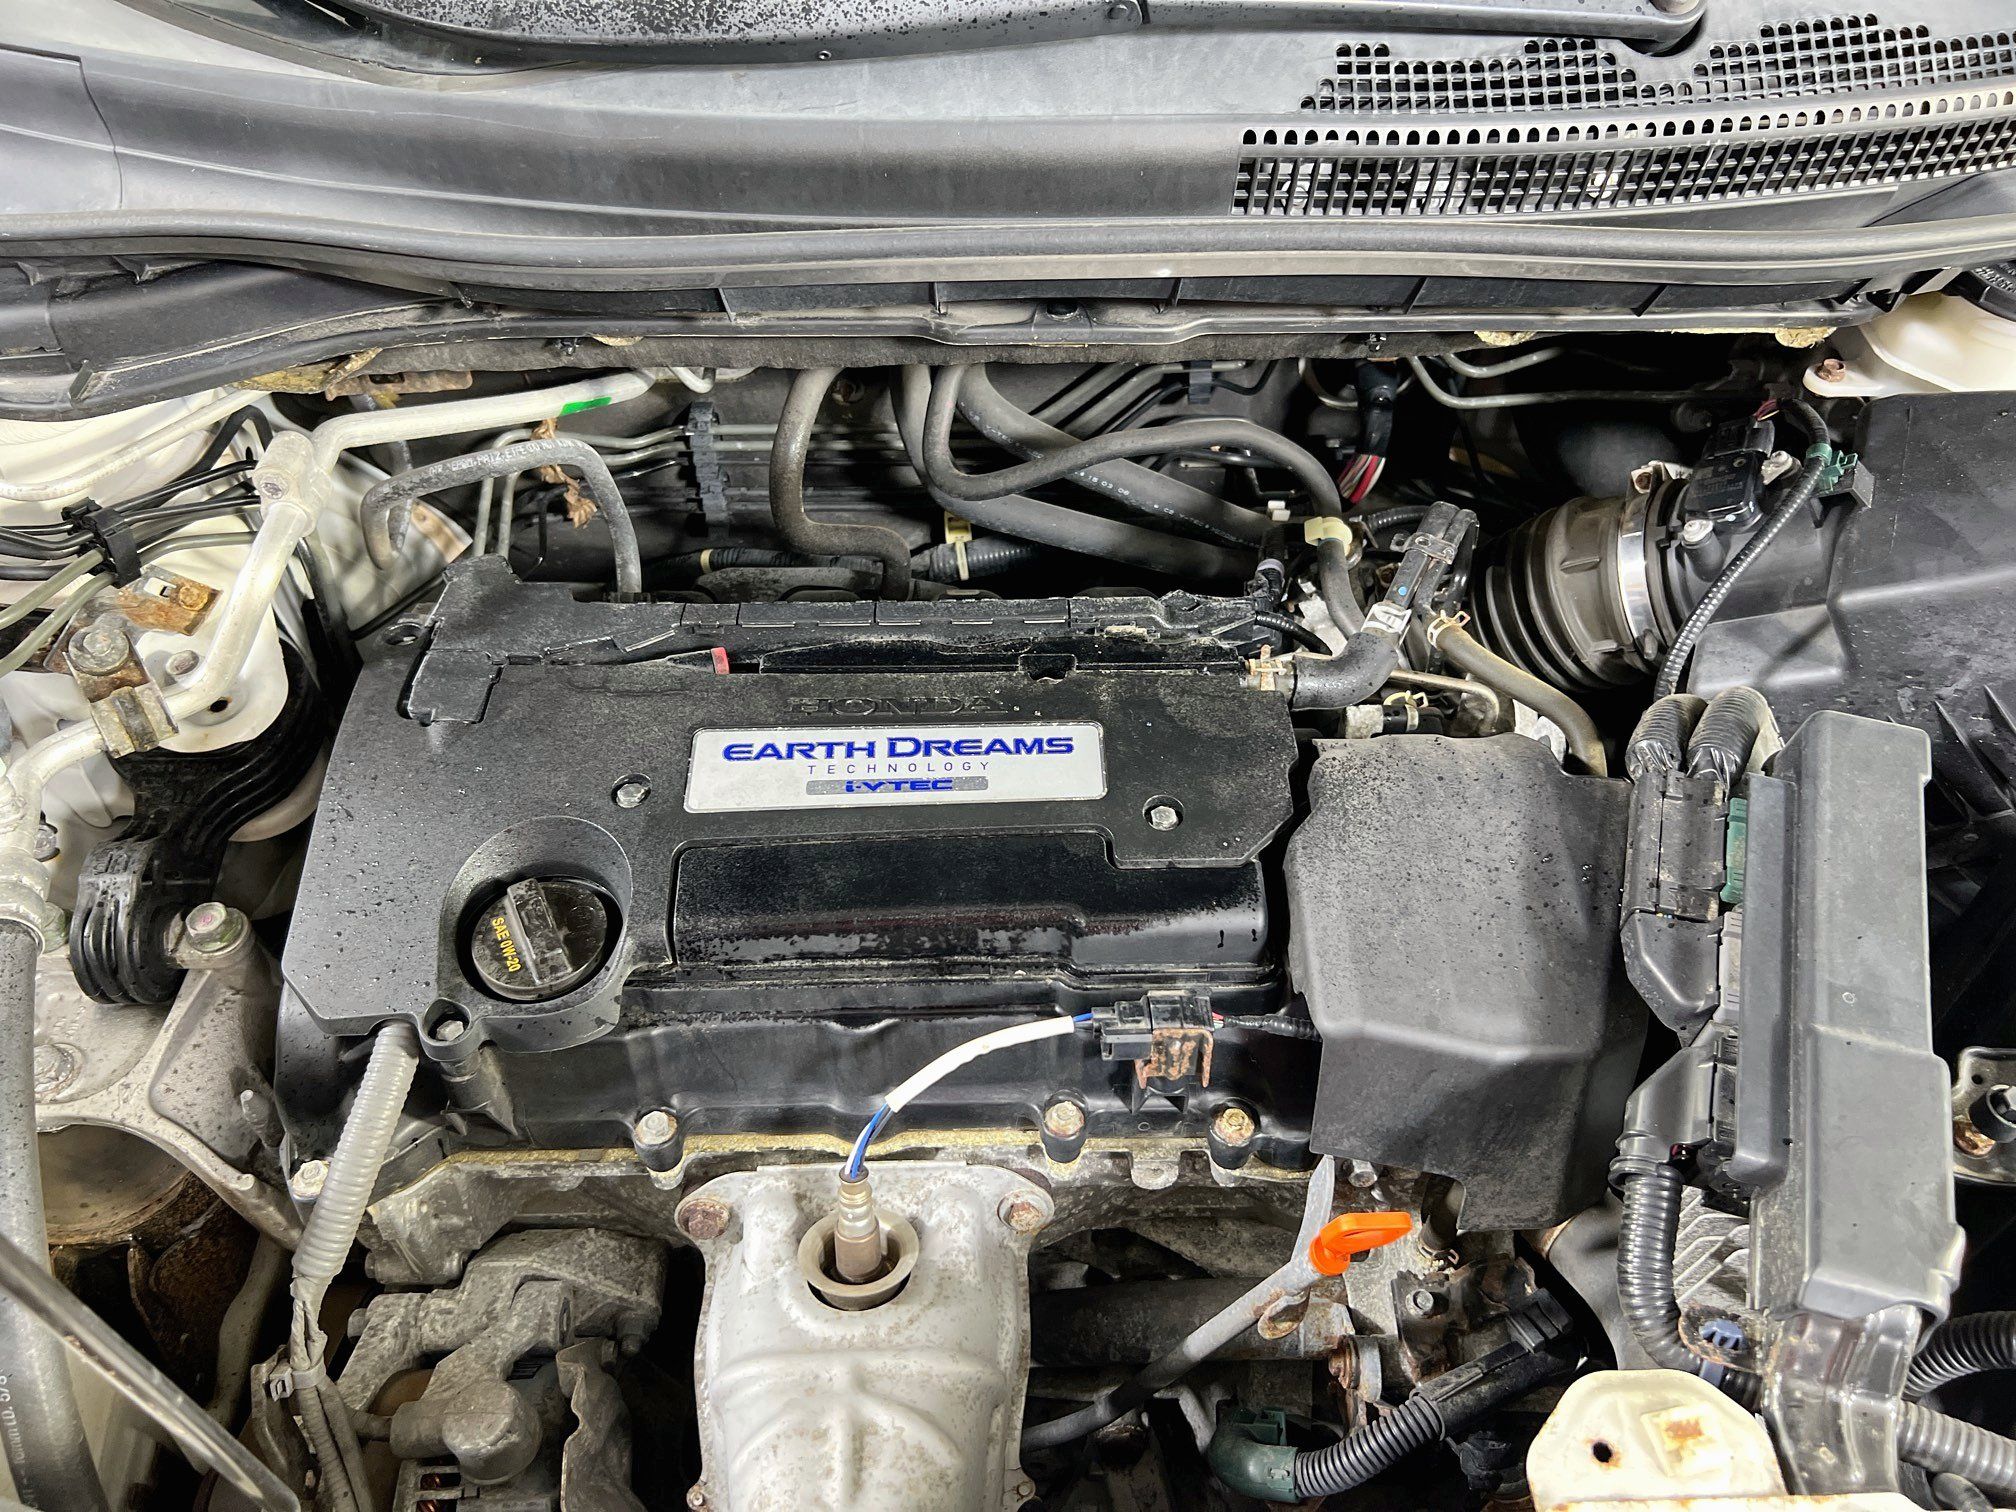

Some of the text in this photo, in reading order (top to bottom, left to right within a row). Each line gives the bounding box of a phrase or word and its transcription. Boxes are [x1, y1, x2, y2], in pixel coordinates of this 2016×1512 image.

[787, 697, 1008, 716] HONDA
[722, 736, 1075, 762] EARTH DREAMS
[807, 761, 991, 775] TECHNOLOGY
[845, 779, 954, 793] i-VTEC
[492, 917, 522, 972] SAE 0W-20
